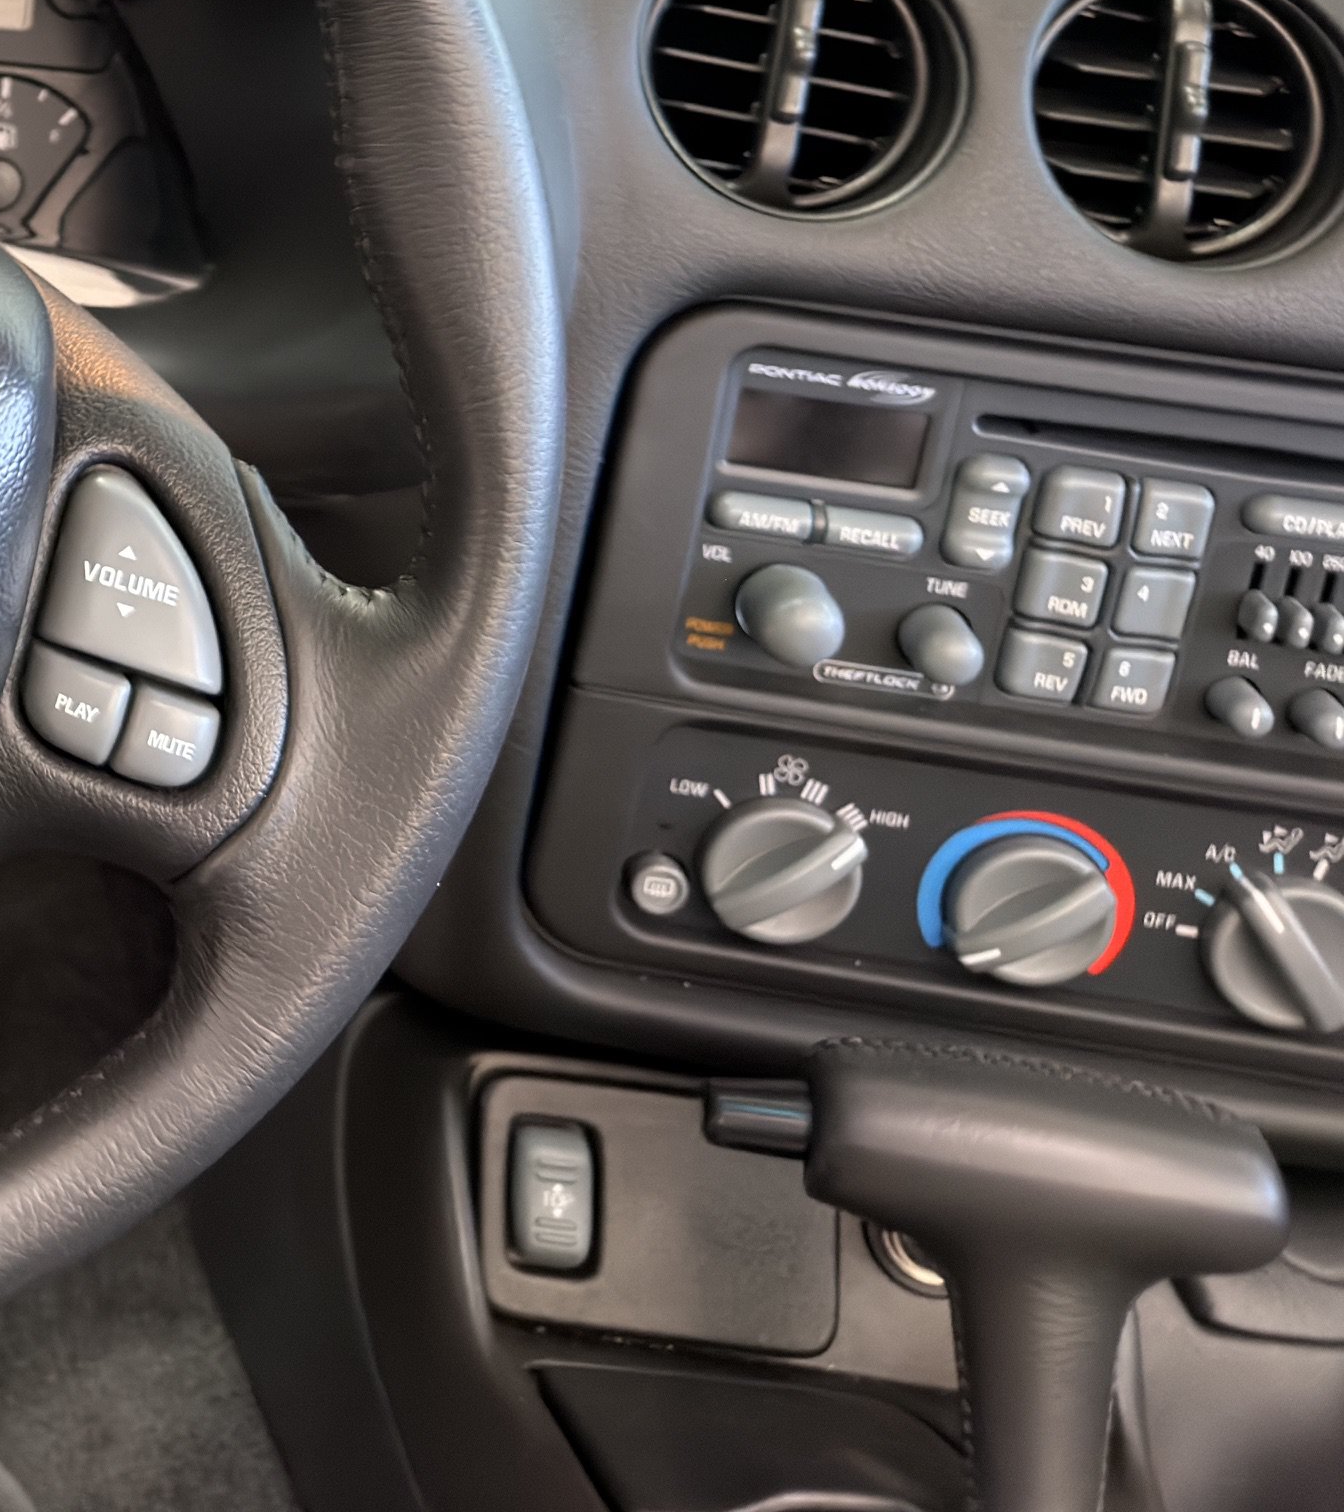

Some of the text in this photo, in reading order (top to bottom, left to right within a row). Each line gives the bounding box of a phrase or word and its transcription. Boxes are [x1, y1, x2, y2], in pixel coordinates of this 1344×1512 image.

[748, 363, 842, 386] PONTIAC
[1103, 495, 1113, 512] 1
[1155, 503, 1169, 520] 2
[738, 510, 802, 534] AM/FM
[967, 506, 1011, 528] SEEK
[1060, 515, 1106, 539] PREV
[839, 525, 900, 549] RECALL
[1150, 529, 1195, 550] NEXT
[702, 544, 732, 563] VOL
[83, 560, 180, 607] VOLUME
[926, 577, 968, 598] TUNE
[1080, 576, 1095, 592] 3
[1137, 586, 1150, 602] 4
[1047, 597, 1088, 618] RDM
[1062, 652, 1075, 668] 5
[1119, 661, 1132, 677] 6
[1227, 649, 1260, 670] BAL
[1034, 672, 1068, 693] REV
[1111, 686, 1148, 706] FWD
[55, 693, 99, 723] PLAY
[148, 729, 198, 761] MUTE
[669, 777, 710, 798] LOW
[869, 808, 910, 829] HIGH
[1155, 869, 1197, 890] MAX
[1143, 910, 1177, 931] OFF
